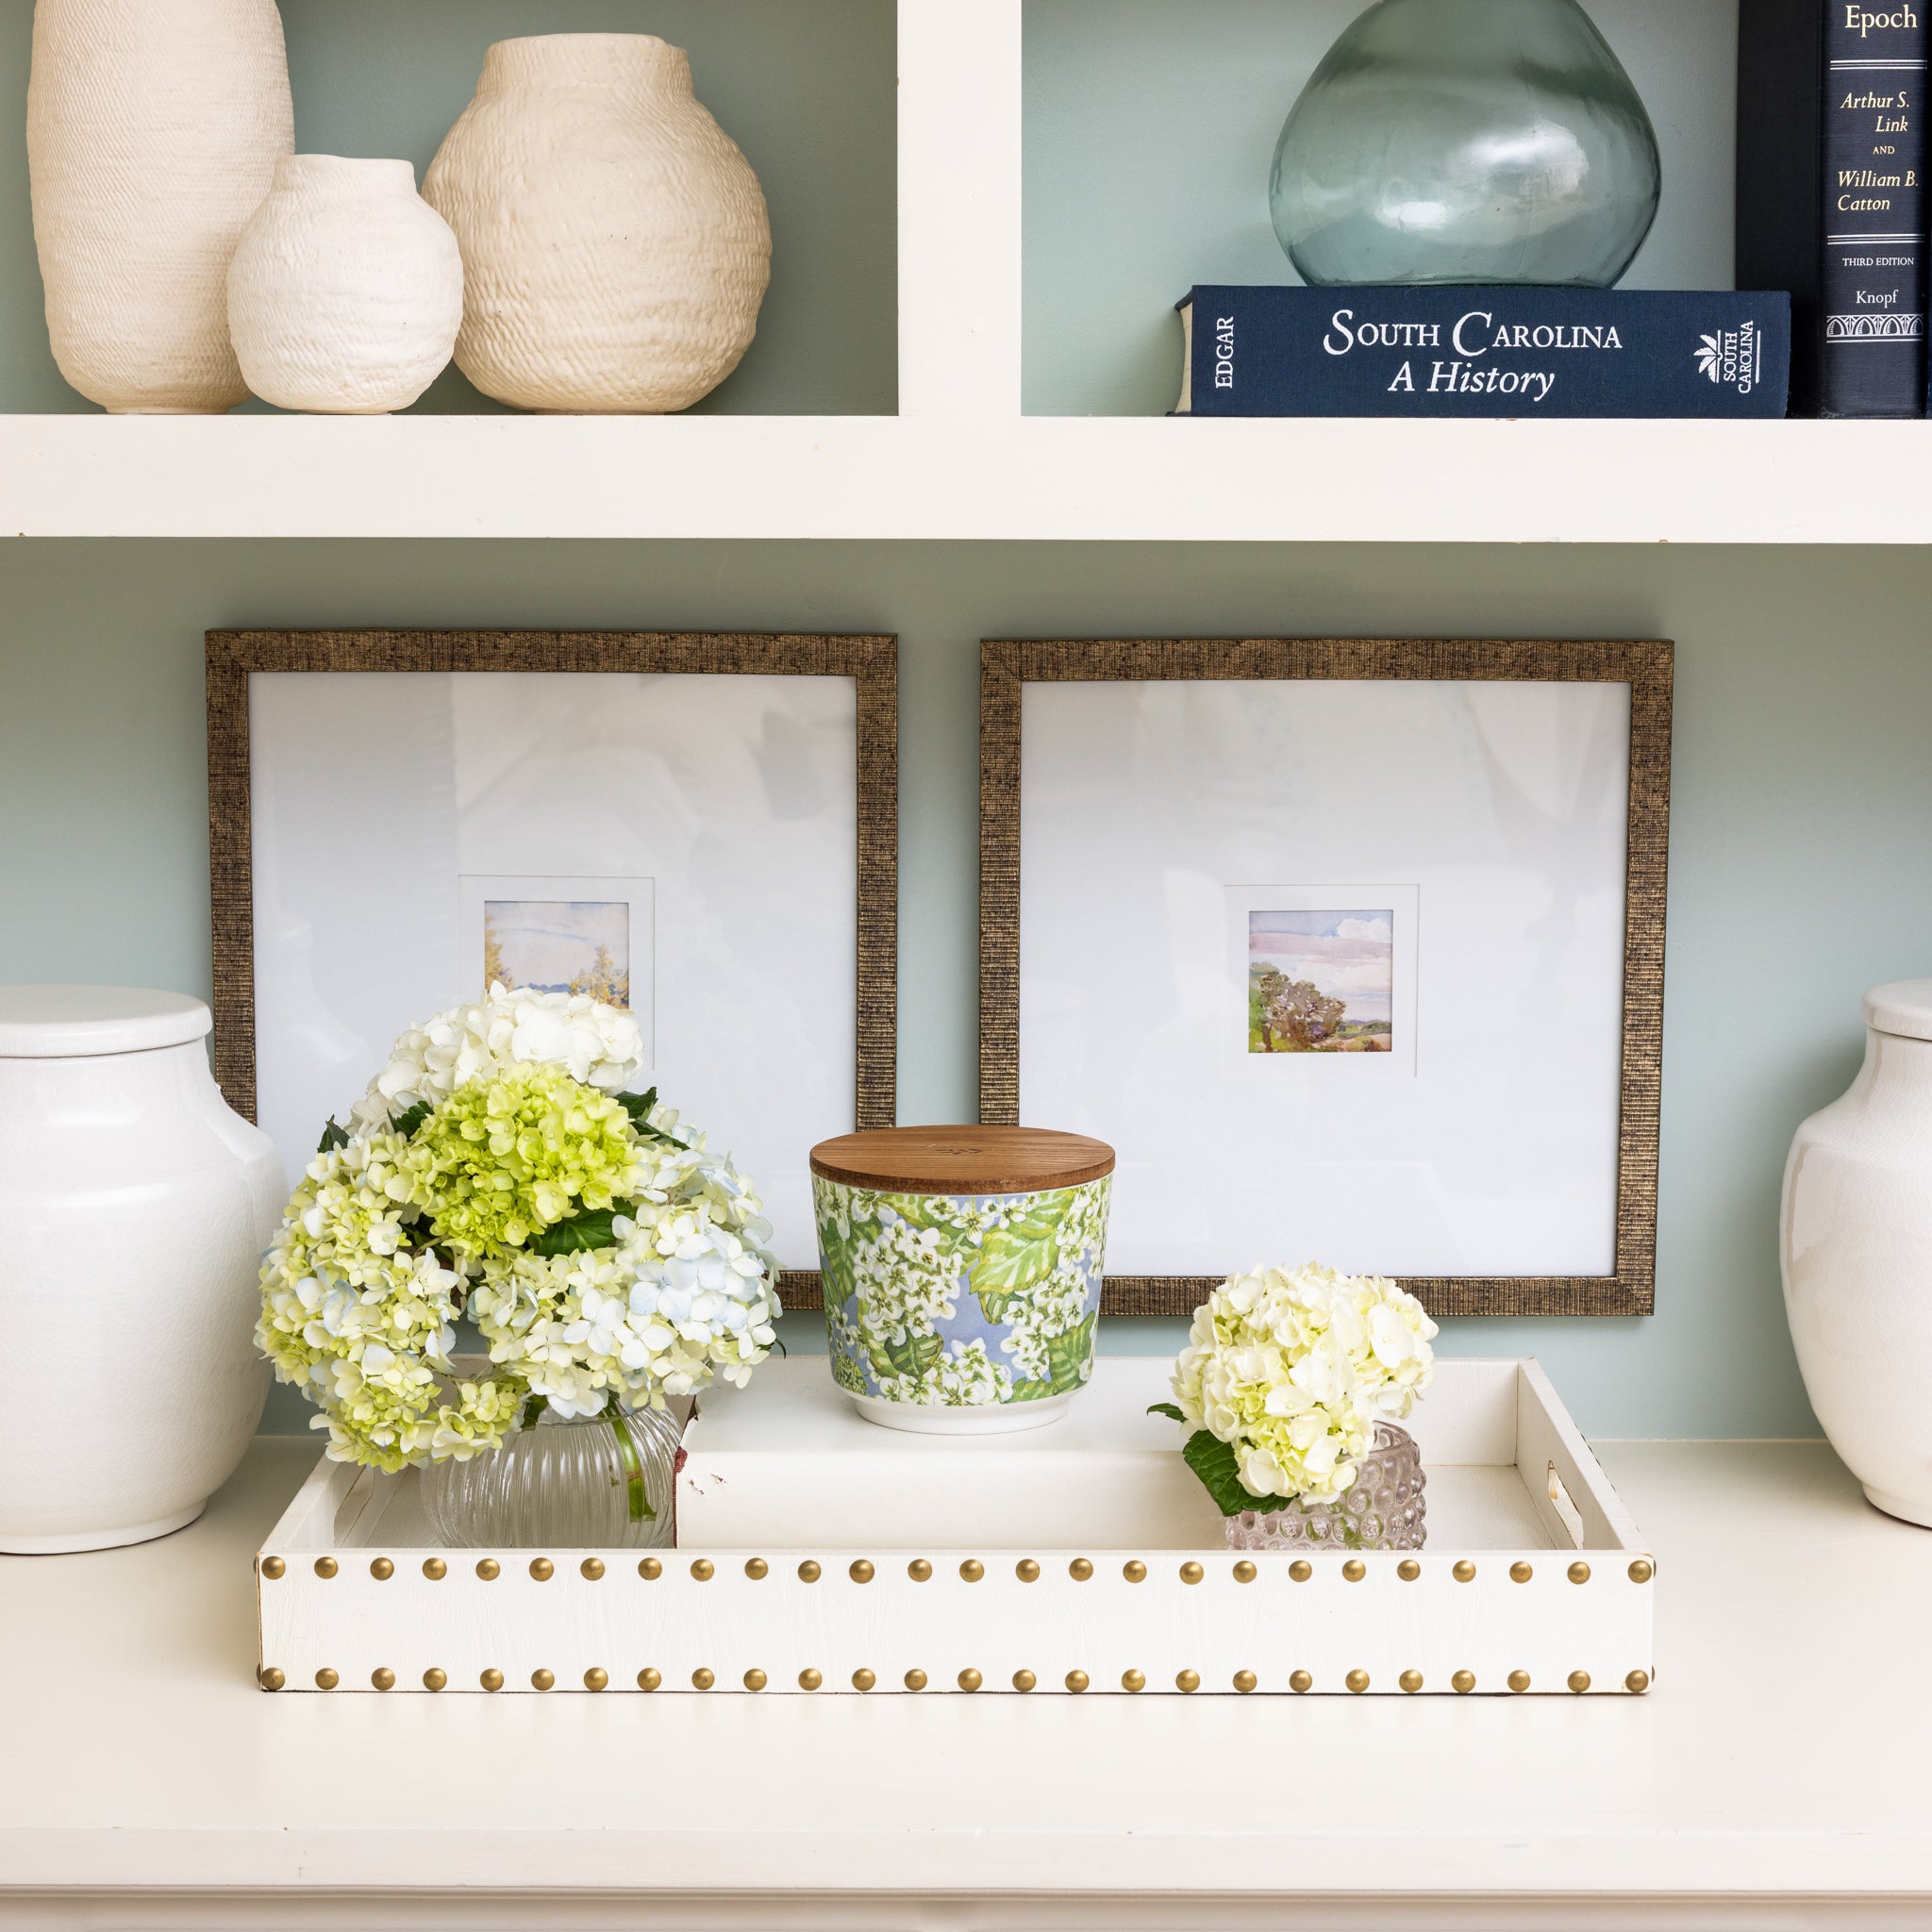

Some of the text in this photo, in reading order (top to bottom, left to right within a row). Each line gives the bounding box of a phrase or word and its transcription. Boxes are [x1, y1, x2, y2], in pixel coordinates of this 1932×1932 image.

[1845, 5, 1917, 37] Epoch
[1840, 92, 1909, 108] Arthur S.
[1875, 116, 1907, 131] Link
[1839, 171, 1919, 186] William B.
[1838, 195, 1890, 210] Catton
[1842, 258, 1874, 266] THIRD
[1857, 290, 1898, 308] Knopf
[1324, 309, 1623, 357] SOUTH CAROLINA
[1215, 317, 1234, 388] EDGAR
[1724, 332, 1737, 381] SOUTH
[1739, 321, 1753, 393] CAROLINA
[1388, 361, 1555, 401] A History
